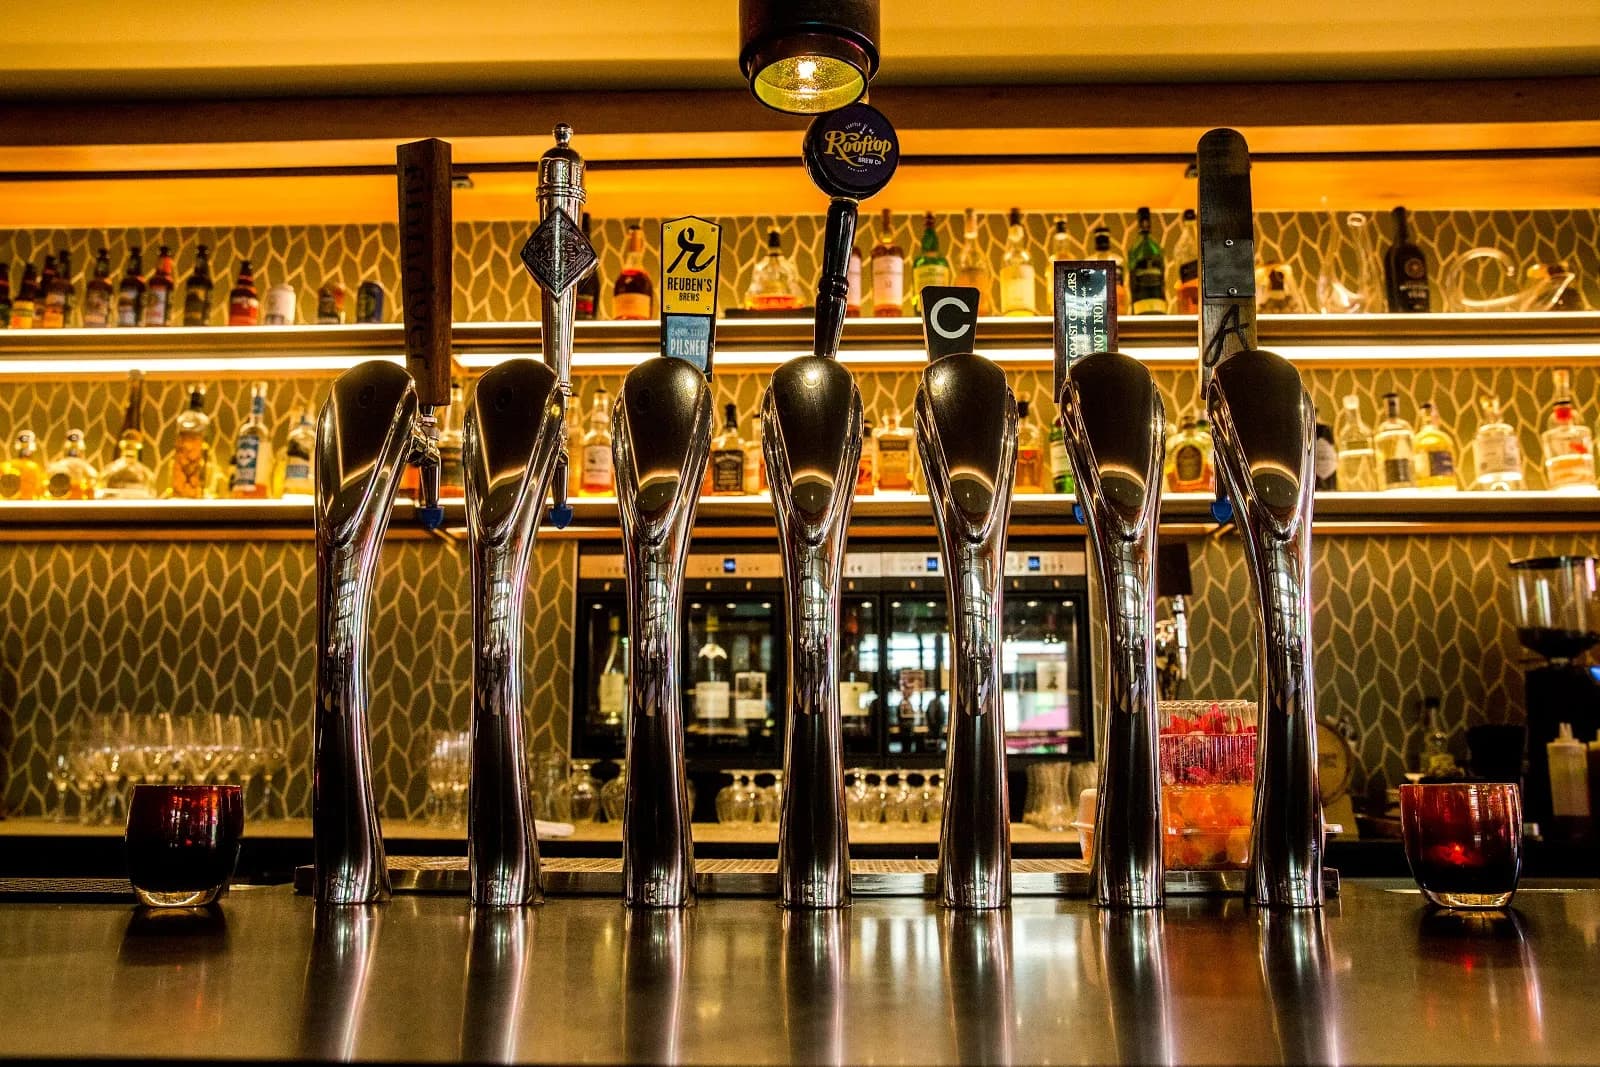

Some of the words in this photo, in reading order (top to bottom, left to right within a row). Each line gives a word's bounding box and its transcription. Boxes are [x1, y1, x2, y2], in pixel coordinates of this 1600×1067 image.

[823, 130, 893, 163] Rooftop
[667, 277, 713, 293] REUBEN'S
[679, 291, 700, 302] BREWS
[930, 296, 971, 339] C
[670, 339, 707, 356] PILSNER
